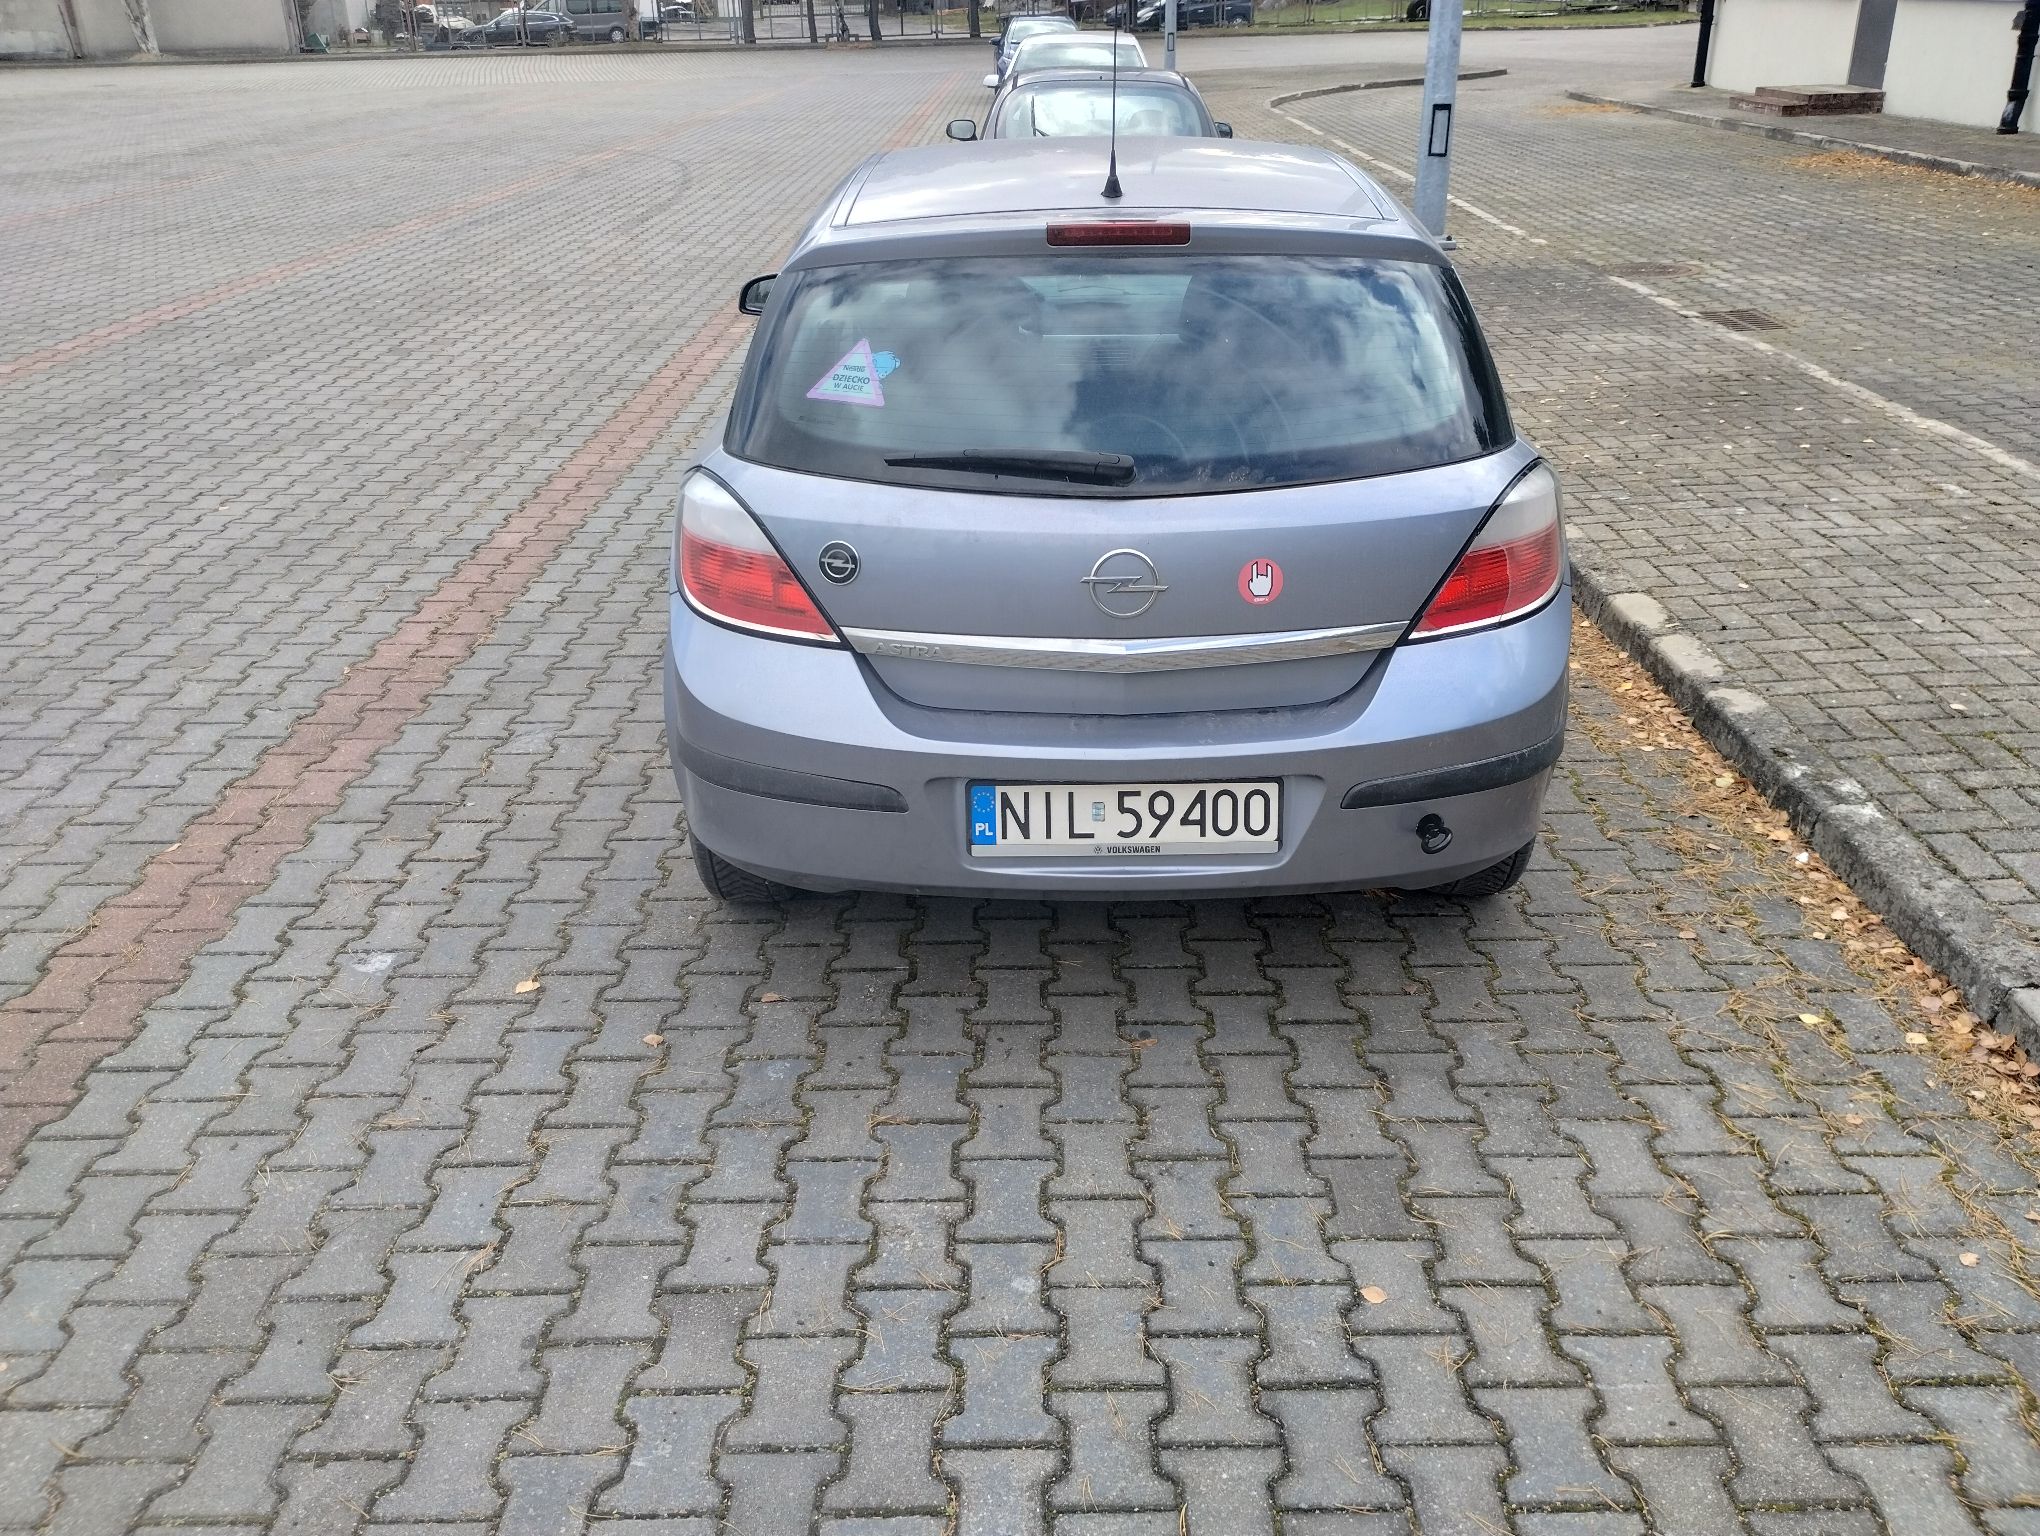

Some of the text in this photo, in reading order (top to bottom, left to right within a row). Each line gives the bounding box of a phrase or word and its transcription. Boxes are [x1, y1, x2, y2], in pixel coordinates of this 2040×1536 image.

[832, 374, 870, 384] DZIECKO
[842, 384, 864, 392] AUCIE
[875, 642, 943, 657] ASTRA
[1000, 788, 1271, 840] NIL 59400
[975, 822, 994, 836] PL
[1106, 845, 1161, 854] VOLKSWAGEN
